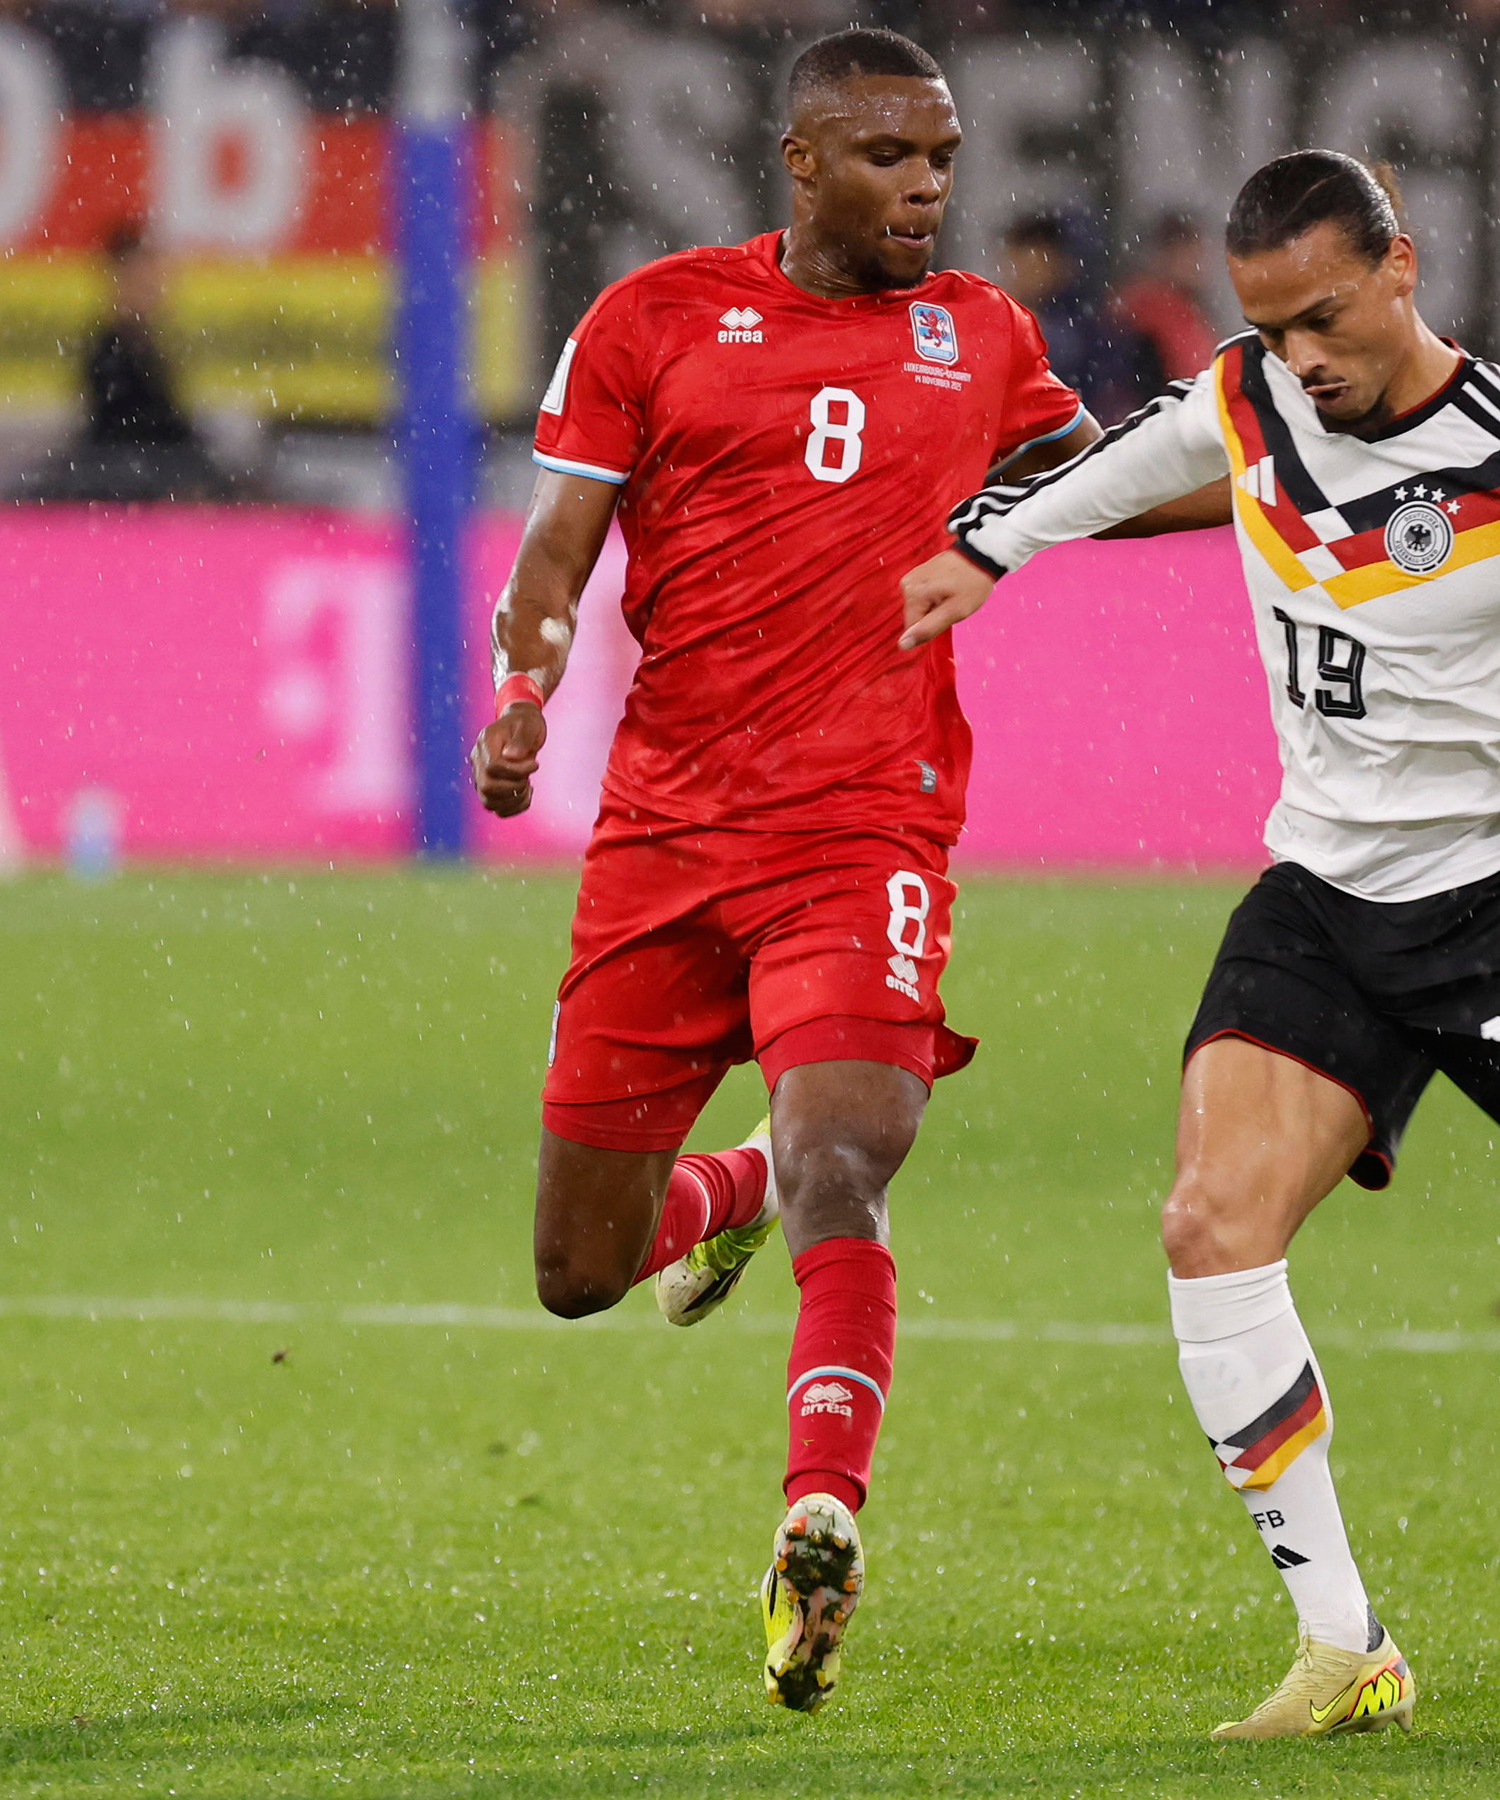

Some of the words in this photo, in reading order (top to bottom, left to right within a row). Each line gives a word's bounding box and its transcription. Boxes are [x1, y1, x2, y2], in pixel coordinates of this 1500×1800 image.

[804, 386, 866, 484] 8
[1271, 604, 1367, 721] 19
[885, 869, 930, 959] 8
[1250, 1509, 1286, 1532] FB
